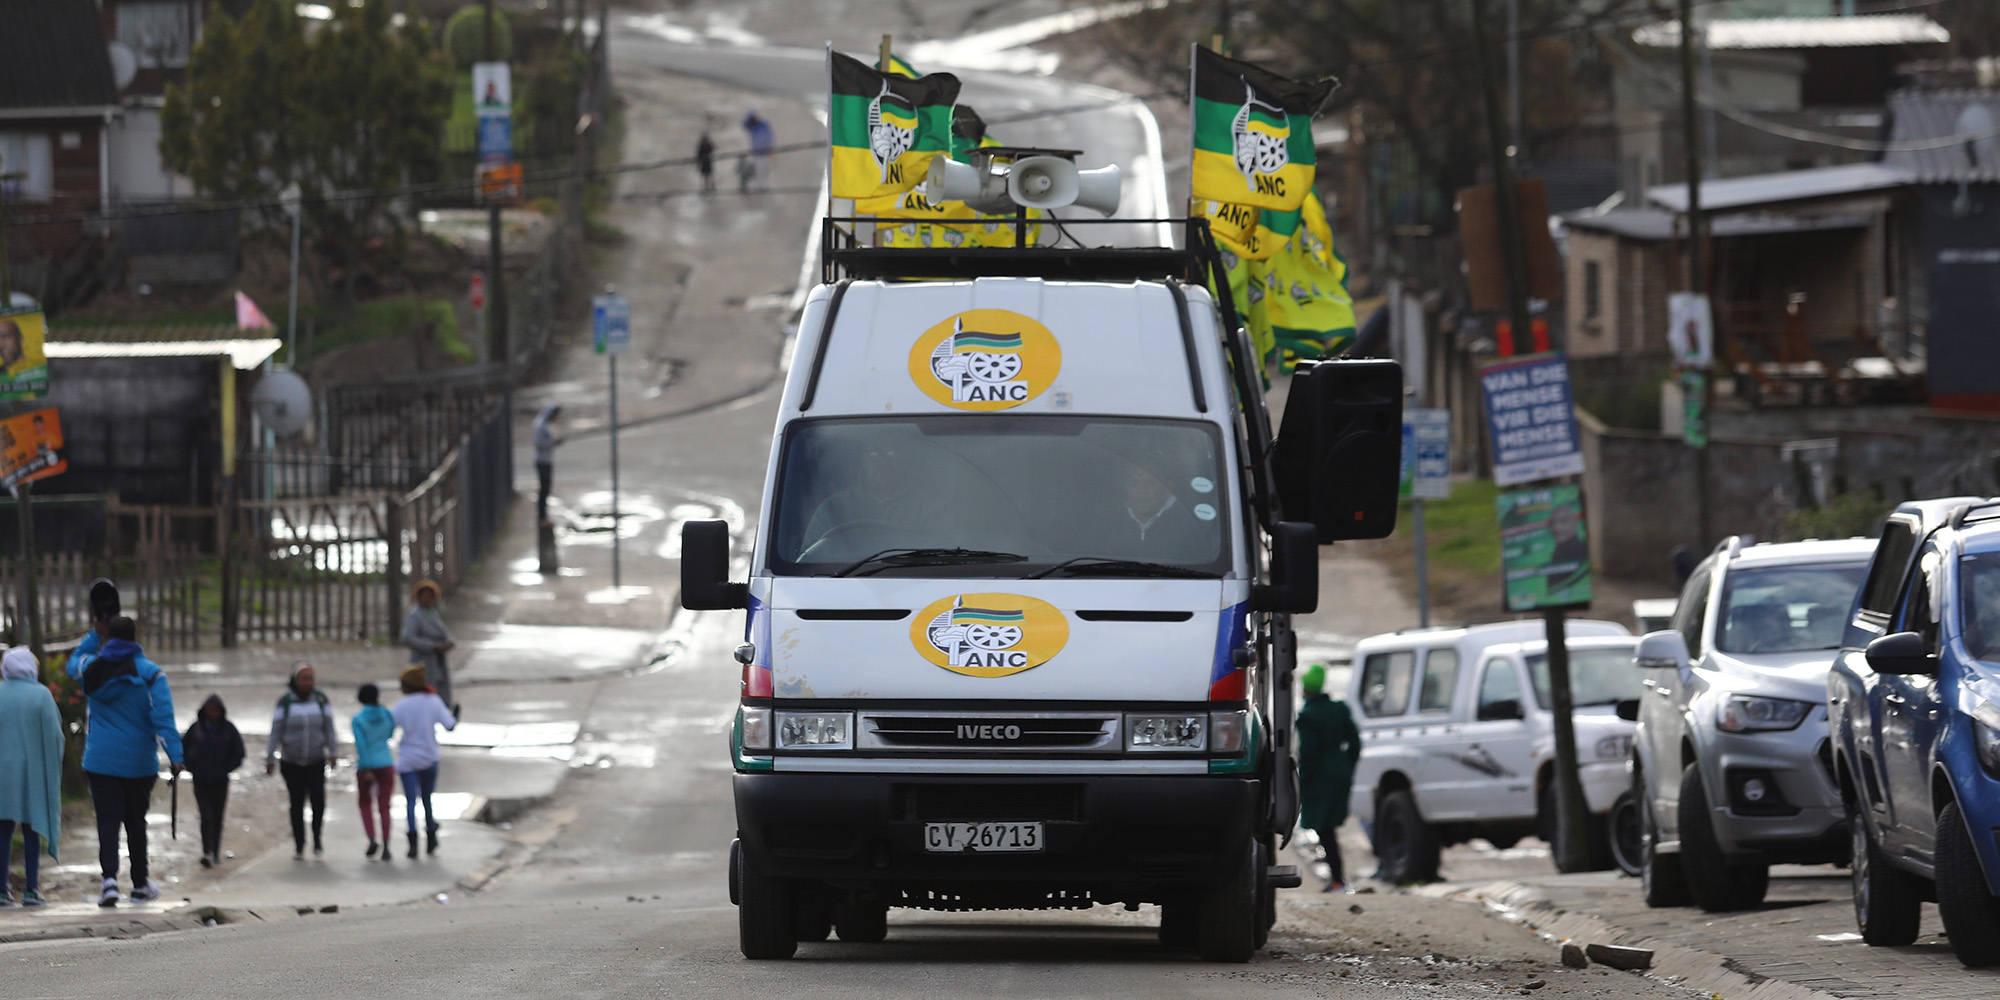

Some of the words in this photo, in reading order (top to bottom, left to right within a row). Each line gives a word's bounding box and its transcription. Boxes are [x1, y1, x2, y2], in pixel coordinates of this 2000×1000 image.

[1255, 175, 1286, 197] ANC
[1217, 203, 1250, 230] ANC
[1482, 371, 1529, 393] VAN
[1530, 363, 1569, 386] DIE
[968, 385, 1027, 401] ANC
[1491, 384, 1565, 412] MENSE
[1492, 409, 1530, 430] VIR
[1532, 402, 1570, 424] DIE
[1497, 422, 1571, 449] MENSE
[965, 653, 1027, 667] ANC
[957, 724, 1021, 740] IVECO
[929, 826, 956, 847] CY
[966, 826, 1036, 847] 26713
